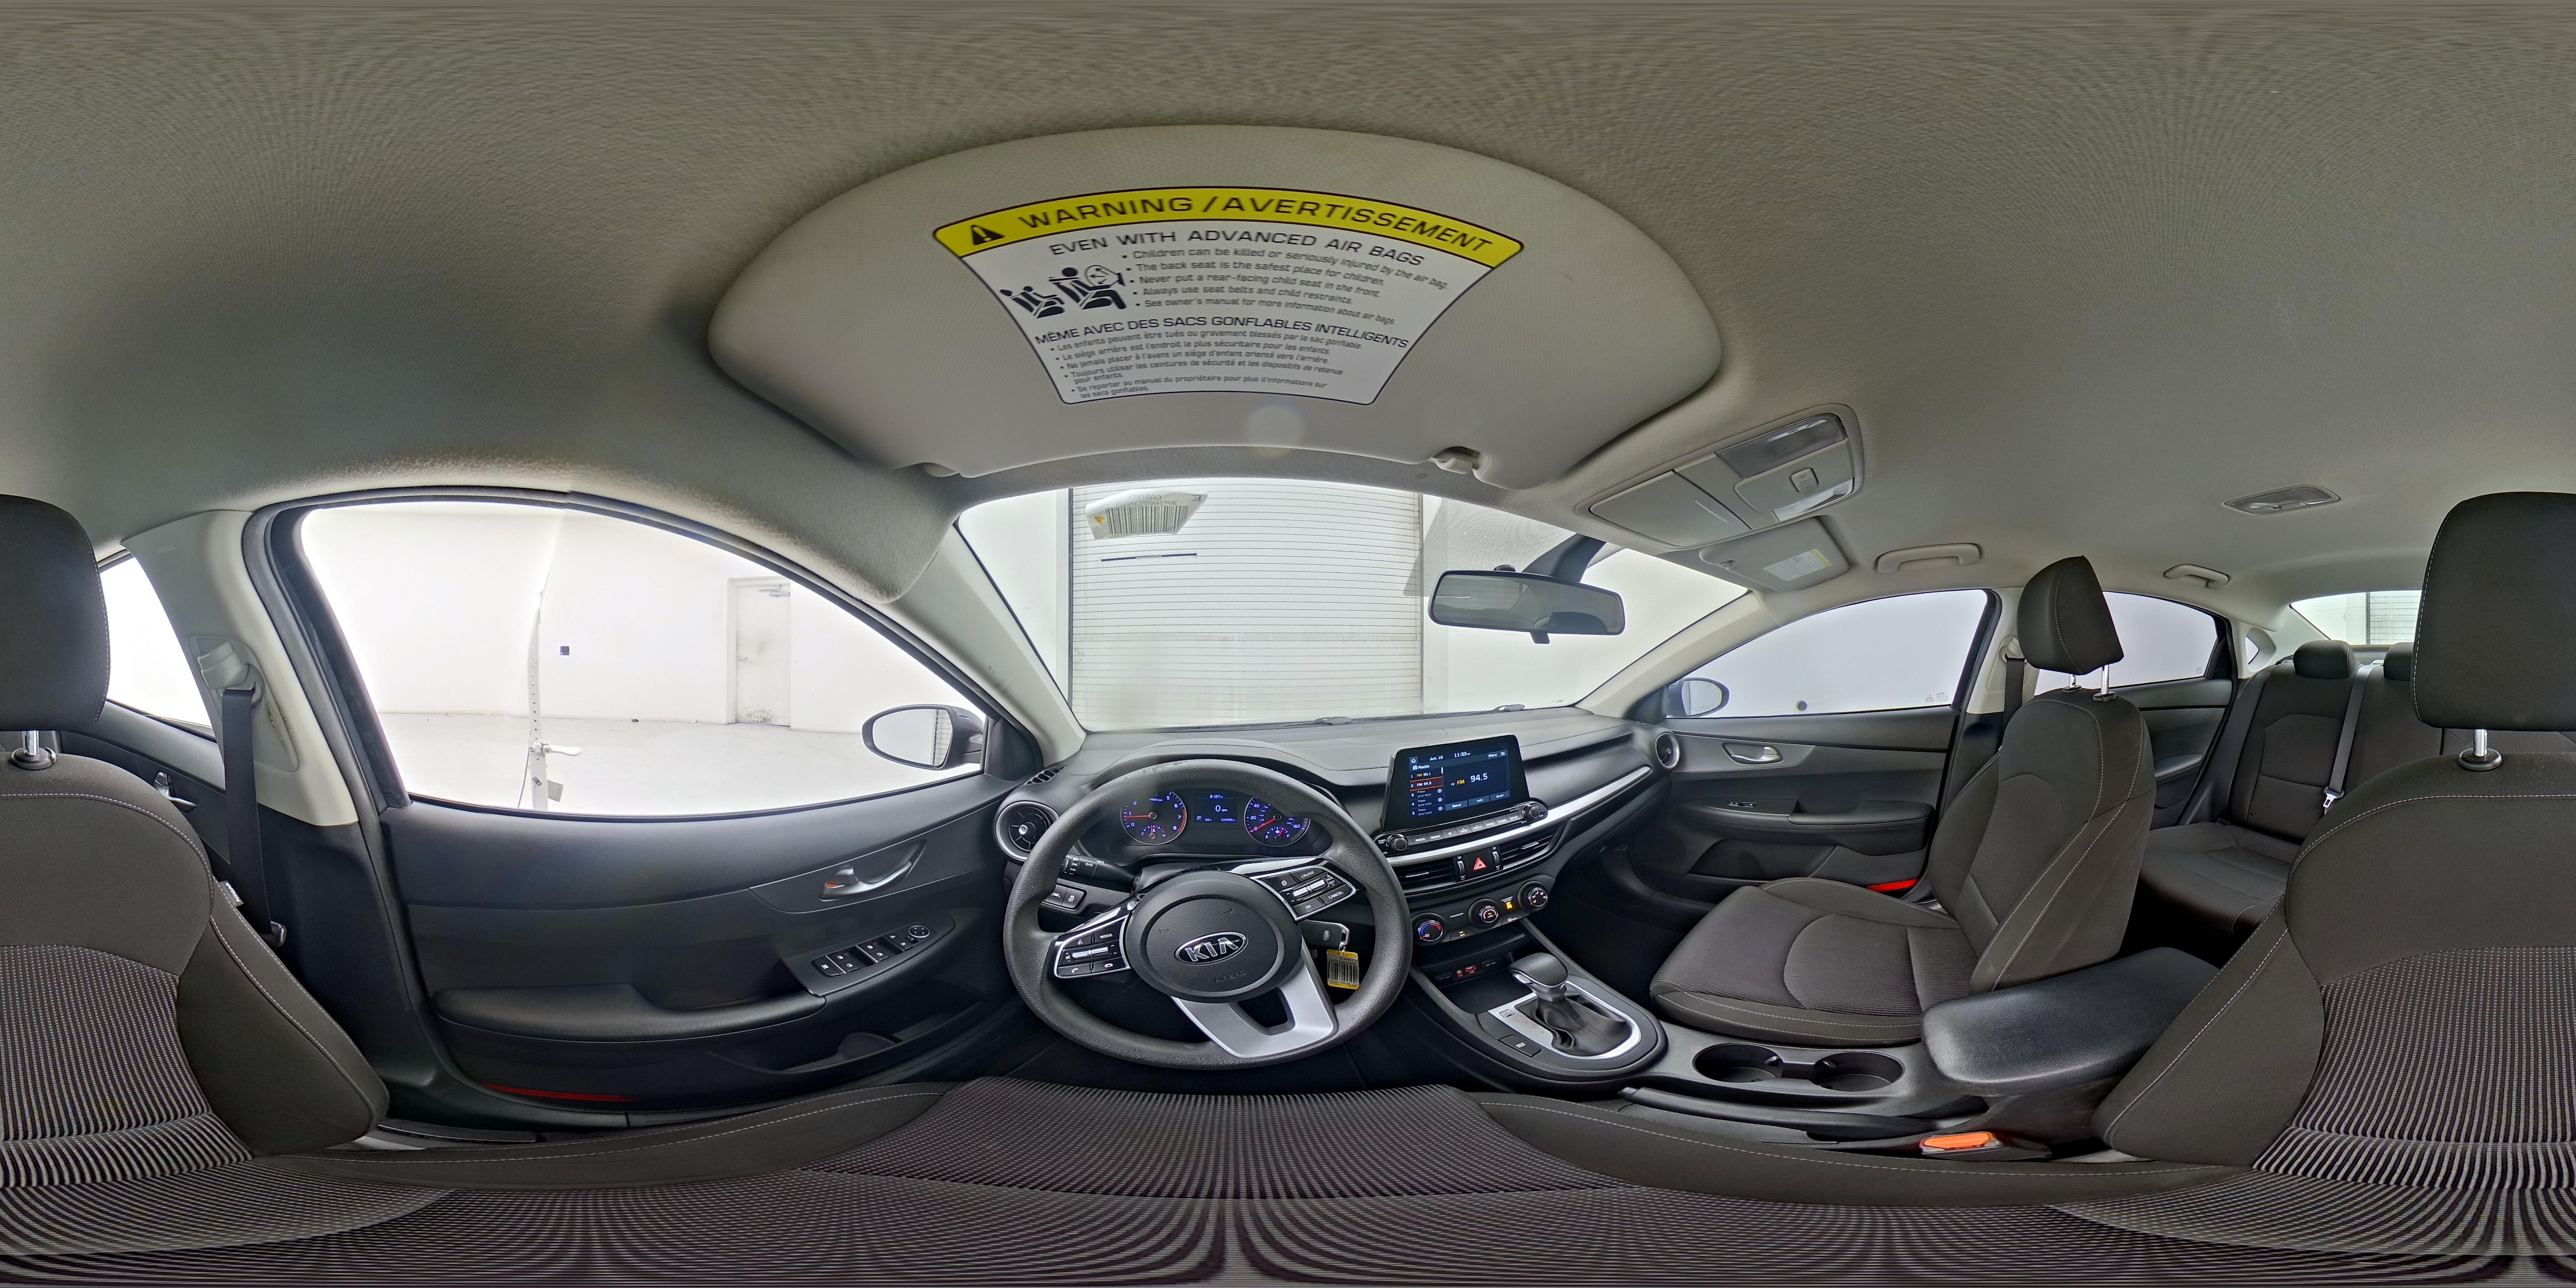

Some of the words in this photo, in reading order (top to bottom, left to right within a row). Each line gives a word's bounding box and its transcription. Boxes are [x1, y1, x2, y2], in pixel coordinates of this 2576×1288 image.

[1017, 196, 1193, 228] WARNING
[1048, 236, 1108, 256] EVEN
[1115, 231, 1176, 245] WITH
[1187, 230, 1317, 246] ADVANCED
[1324, 238, 1363, 252] AIR
[1367, 245, 1425, 266] BAGS
[1131, 248, 1185, 259] Children
[1214, 247, 1230, 256] be
[1232, 247, 1266, 257] killed
[1284, 251, 1339, 266] seriously
[1340, 257, 1380, 272] injured
[1379, 265, 1395, 276] by
[1394, 268, 1414, 279] the
[1412, 274, 1429, 282] air
[1428, 277, 1451, 290] bag.
[1134, 263, 1158, 272] The
[1159, 261, 1188, 270] back
[1190, 261, 1217, 269] seat
[1219, 260, 1230, 268] is
[1232, 261, 1252, 269] the
[1253, 262, 1292, 272] safest
[1291, 265, 1323, 275] place
[1324, 268, 1342, 277] for
[1342, 272, 1384, 286] children.
[1138, 275, 1172, 284] Never
[1174, 274, 1194, 284] put
[1206, 273, 1270, 285] rear-facing
[1270, 275, 1298, 285] child
[1298, 279, 1323, 288] seat
[1324, 281, 1334, 290] in
[1335, 283, 1353, 293] the
[1354, 286, 1380, 297] front.
[1142, 287, 1179, 296] Always
[1228, 285, 1255, 294] belts
[1256, 287, 1276, 295] and
[1277, 288, 1302, 297] child
[1302, 291, 1352, 304] restraints.
[1143, 299, 1163, 308] See
[1241, 297, 1256, 306] for
[1257, 299, 1282, 308] more
[1283, 301, 1336, 313] information
[1336, 308, 1362, 318] about
[1374, 314, 1397, 325] bags.
[1034, 328, 1080, 344] MÊME
[1083, 321, 1124, 336] AVEC
[1127, 318, 1159, 330] DES
[1162, 316, 1207, 327] SACS
[1211, 316, 1313, 331] GONFLABLES
[1314, 323, 1410, 348] INTELLIGENTS
[1073, 337, 1106, 348] enfants
[1107, 333, 1142, 345] peuvent
[1143, 331, 1163, 339] être
[1248, 330, 1282, 339] blessés
[1299, 333, 1309, 342] le
[1324, 338, 1362, 349] gonflable.
[1073, 349, 1096, 359] siège
[1097, 345, 1128, 355] arrière
[1193, 340, 1212, 348] plus
[1213, 338, 1261, 348] sécuritaire
[1284, 343, 1297, 351] les
[1298, 345, 1330, 354] enfants.
[1078, 358, 1106, 368] jamais
[1107, 354, 1133, 365] placer
[1184, 349, 1207, 359] siège
[1244, 350, 1275, 359] orienté
[1470, 772, 1488, 783] 94.5
[1300, 870, 1315, 879] CRUISE
[225, 882, 241, 902] AIRBAG
[1328, 890, 1344, 900] CANCEL
[1184, 937, 1239, 962] KIA
[1215, 969, 1247, 984] AIRBAG
